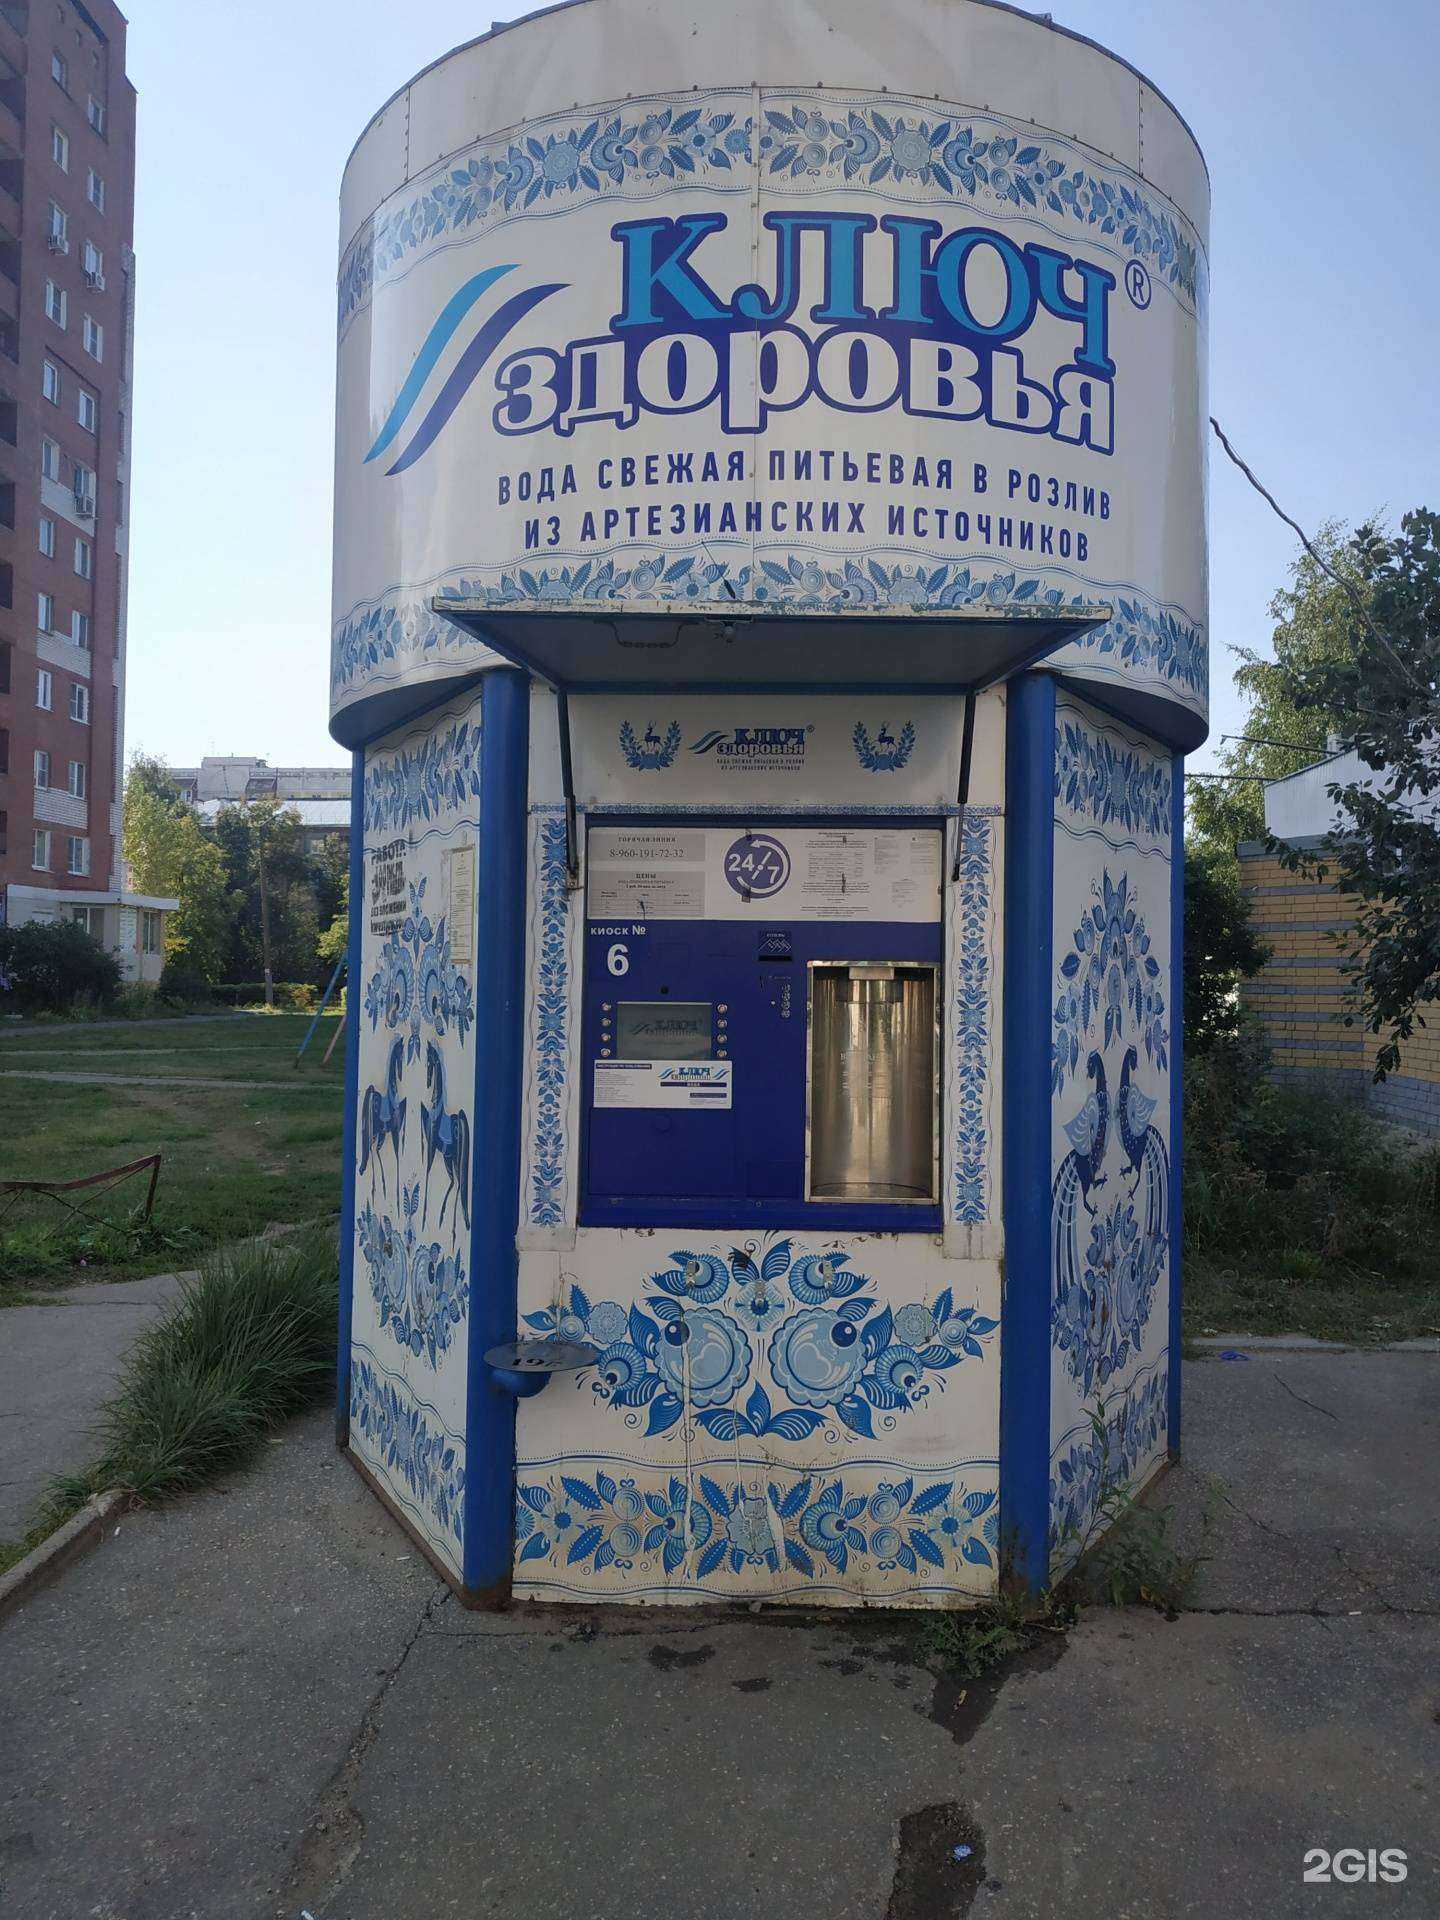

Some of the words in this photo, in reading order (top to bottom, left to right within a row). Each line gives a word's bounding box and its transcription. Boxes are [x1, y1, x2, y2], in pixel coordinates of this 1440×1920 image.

[609, 210, 1116, 380] КЛЮЧ
[497, 463, 578, 506] ВОДА
[597, 450, 745, 490] СВЕЖАЯ
[768, 449, 952, 490] ПИТЬЕВАЯ
[973, 462, 988, 494] В
[1007, 468, 1111, 521] РОЗЛИВ
[524, 515, 561, 550] ИЗ
[579, 500, 866, 543] АРТЕЗИАНСКИХ
[887, 504, 1089, 563] ИСТОЧНИКОВ
[734, 728, 805, 745] КЛЮЧ
[607, 943, 630, 977] 6
